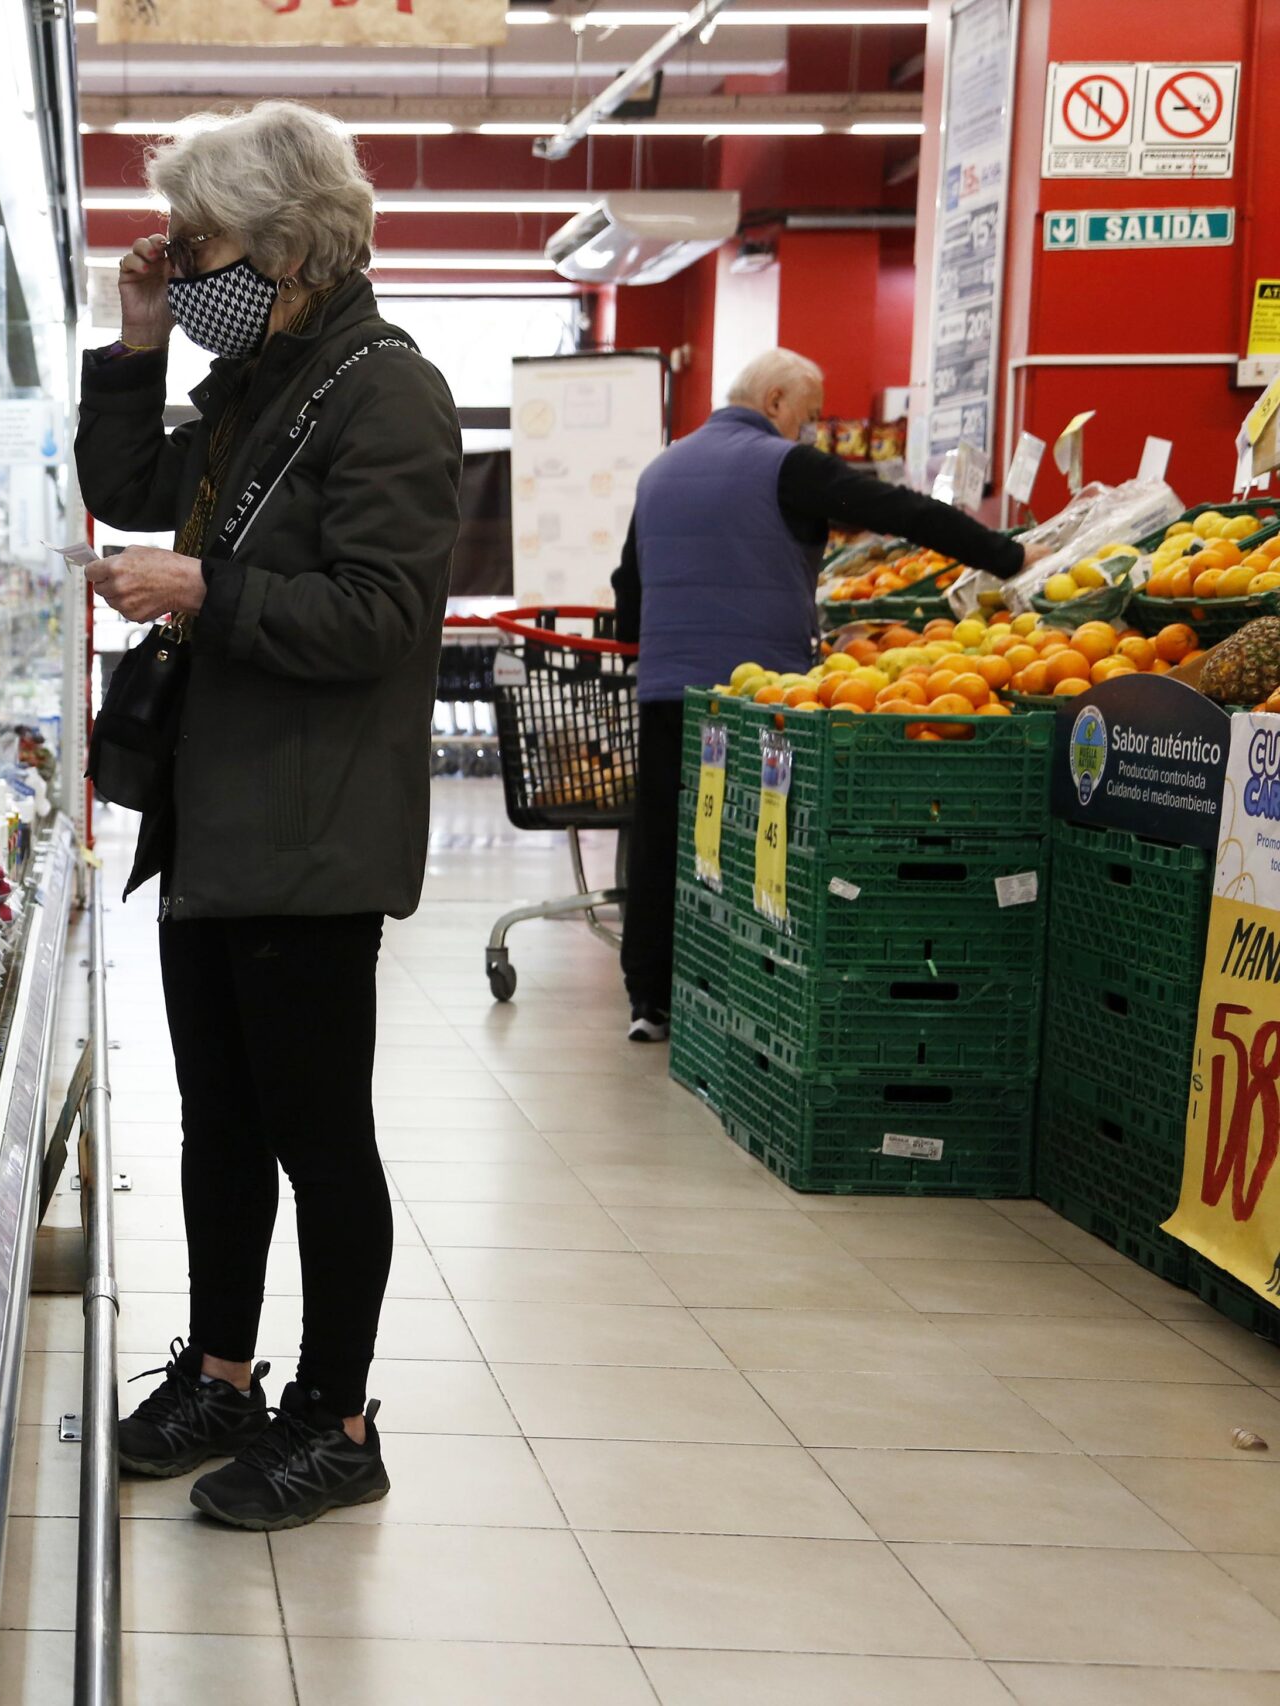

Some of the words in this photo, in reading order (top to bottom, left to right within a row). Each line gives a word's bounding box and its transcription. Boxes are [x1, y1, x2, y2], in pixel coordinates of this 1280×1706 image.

[1104, 214, 1211, 241] SALIDA
[224, 480, 262, 534] LET'S
[1111, 725, 1150, 755] Sabor
[1151, 731, 1221, 765] auténtico
[1118, 759, 1159, 782] Producción
[1159, 769, 1206, 790] controlada
[1106, 779, 1142, 801] Cuidando
[1142, 788, 1151, 802] el
[1151, 789, 1217, 815] medioambiente
